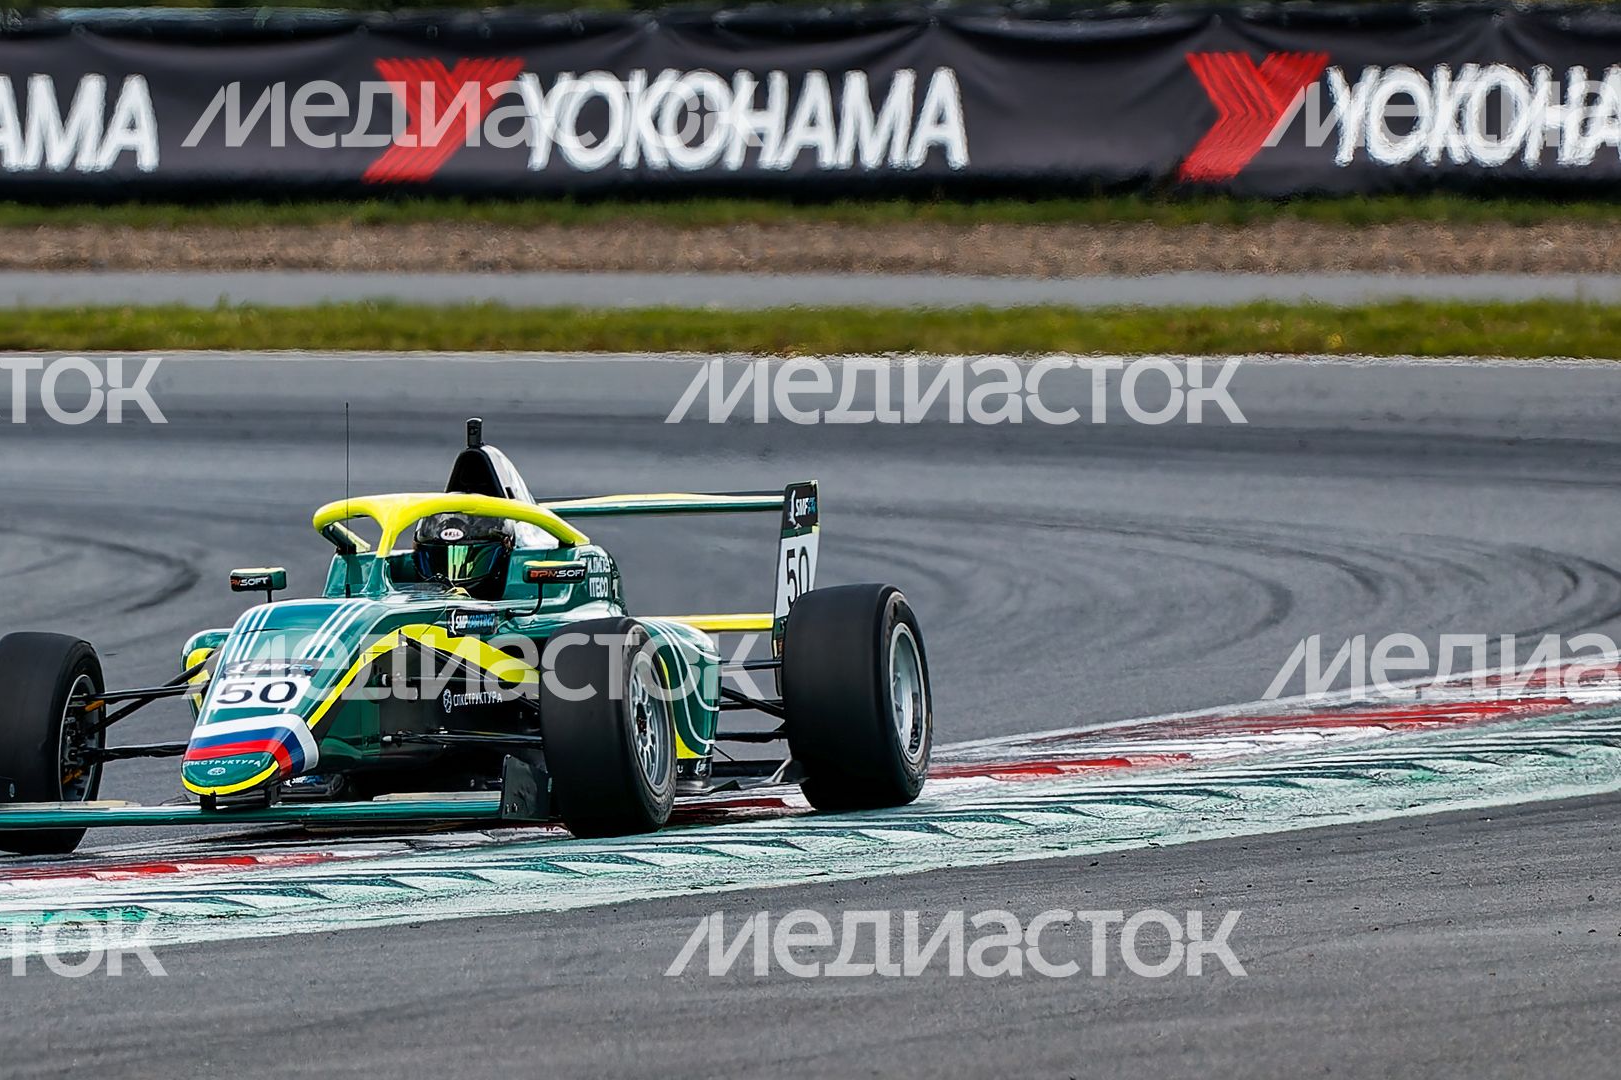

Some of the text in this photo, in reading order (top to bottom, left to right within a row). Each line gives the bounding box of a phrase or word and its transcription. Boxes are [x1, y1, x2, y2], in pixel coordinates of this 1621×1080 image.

[517, 66, 970, 171] YOKOHAMA
[786, 545, 810, 612] 50
[216, 681, 298, 705] 50
